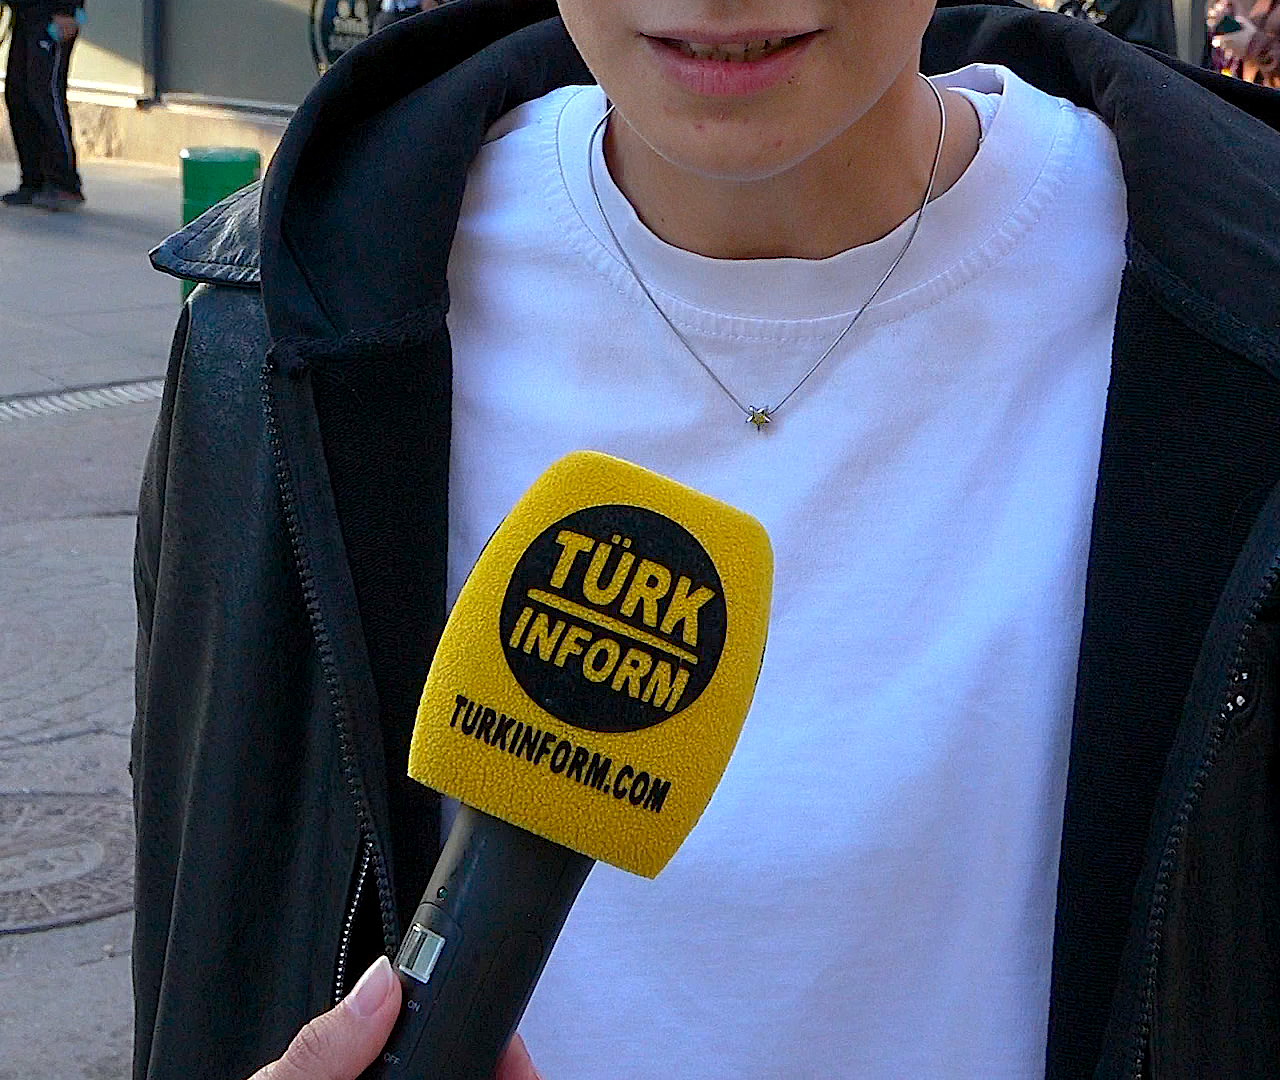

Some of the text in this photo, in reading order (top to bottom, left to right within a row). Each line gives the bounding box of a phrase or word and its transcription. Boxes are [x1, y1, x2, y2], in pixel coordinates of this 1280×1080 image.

[549, 529, 717, 648] TÜRK
[508, 606, 691, 712] INFORM
[449, 694, 672, 813] TURKINFORM.COM
